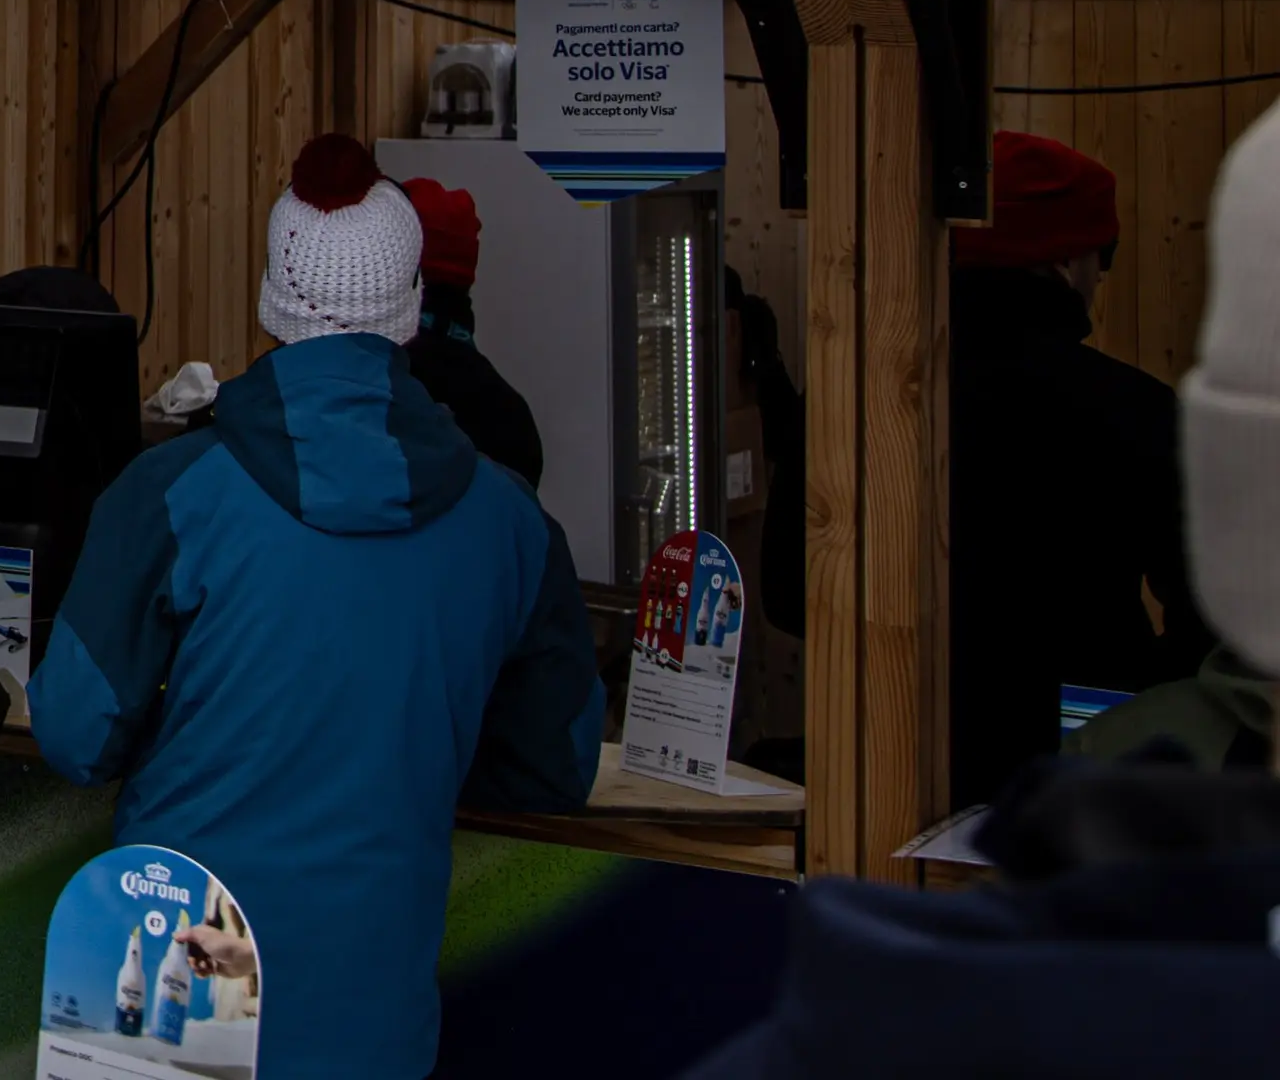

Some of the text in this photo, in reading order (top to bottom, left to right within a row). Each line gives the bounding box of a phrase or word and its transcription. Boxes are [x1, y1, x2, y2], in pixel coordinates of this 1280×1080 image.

[556, 21, 681, 36] Pagamenti con carta?
[552, 38, 685, 58] Accettiamo
[567, 61, 615, 81] solo
[574, 91, 662, 104] Card payment?
[561, 106, 581, 116] We
[582, 106, 622, 118] accept
[623, 105, 648, 118] only
[120, 870, 191, 905] Corona
